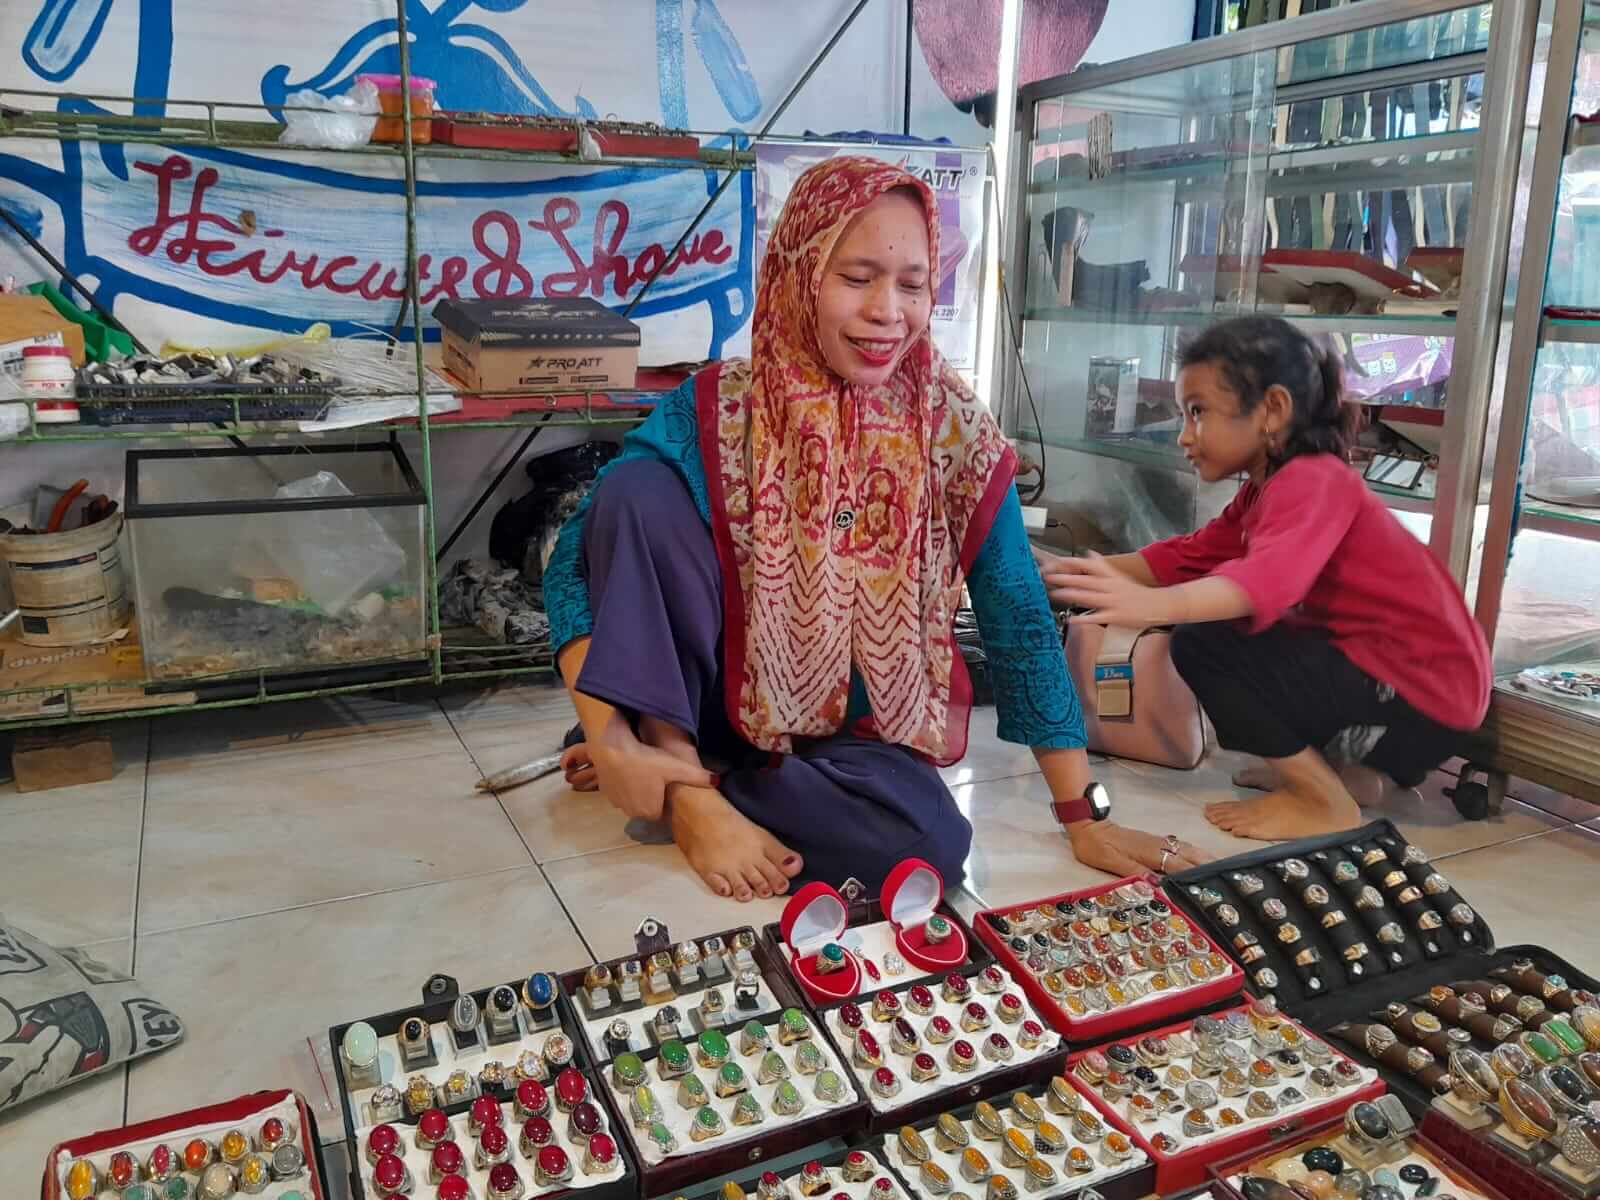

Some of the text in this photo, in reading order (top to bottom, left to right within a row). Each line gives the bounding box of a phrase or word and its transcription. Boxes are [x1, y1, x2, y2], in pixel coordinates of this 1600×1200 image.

[528, 197, 732, 299] Shave
[547, 357, 603, 370] PRO ATT
